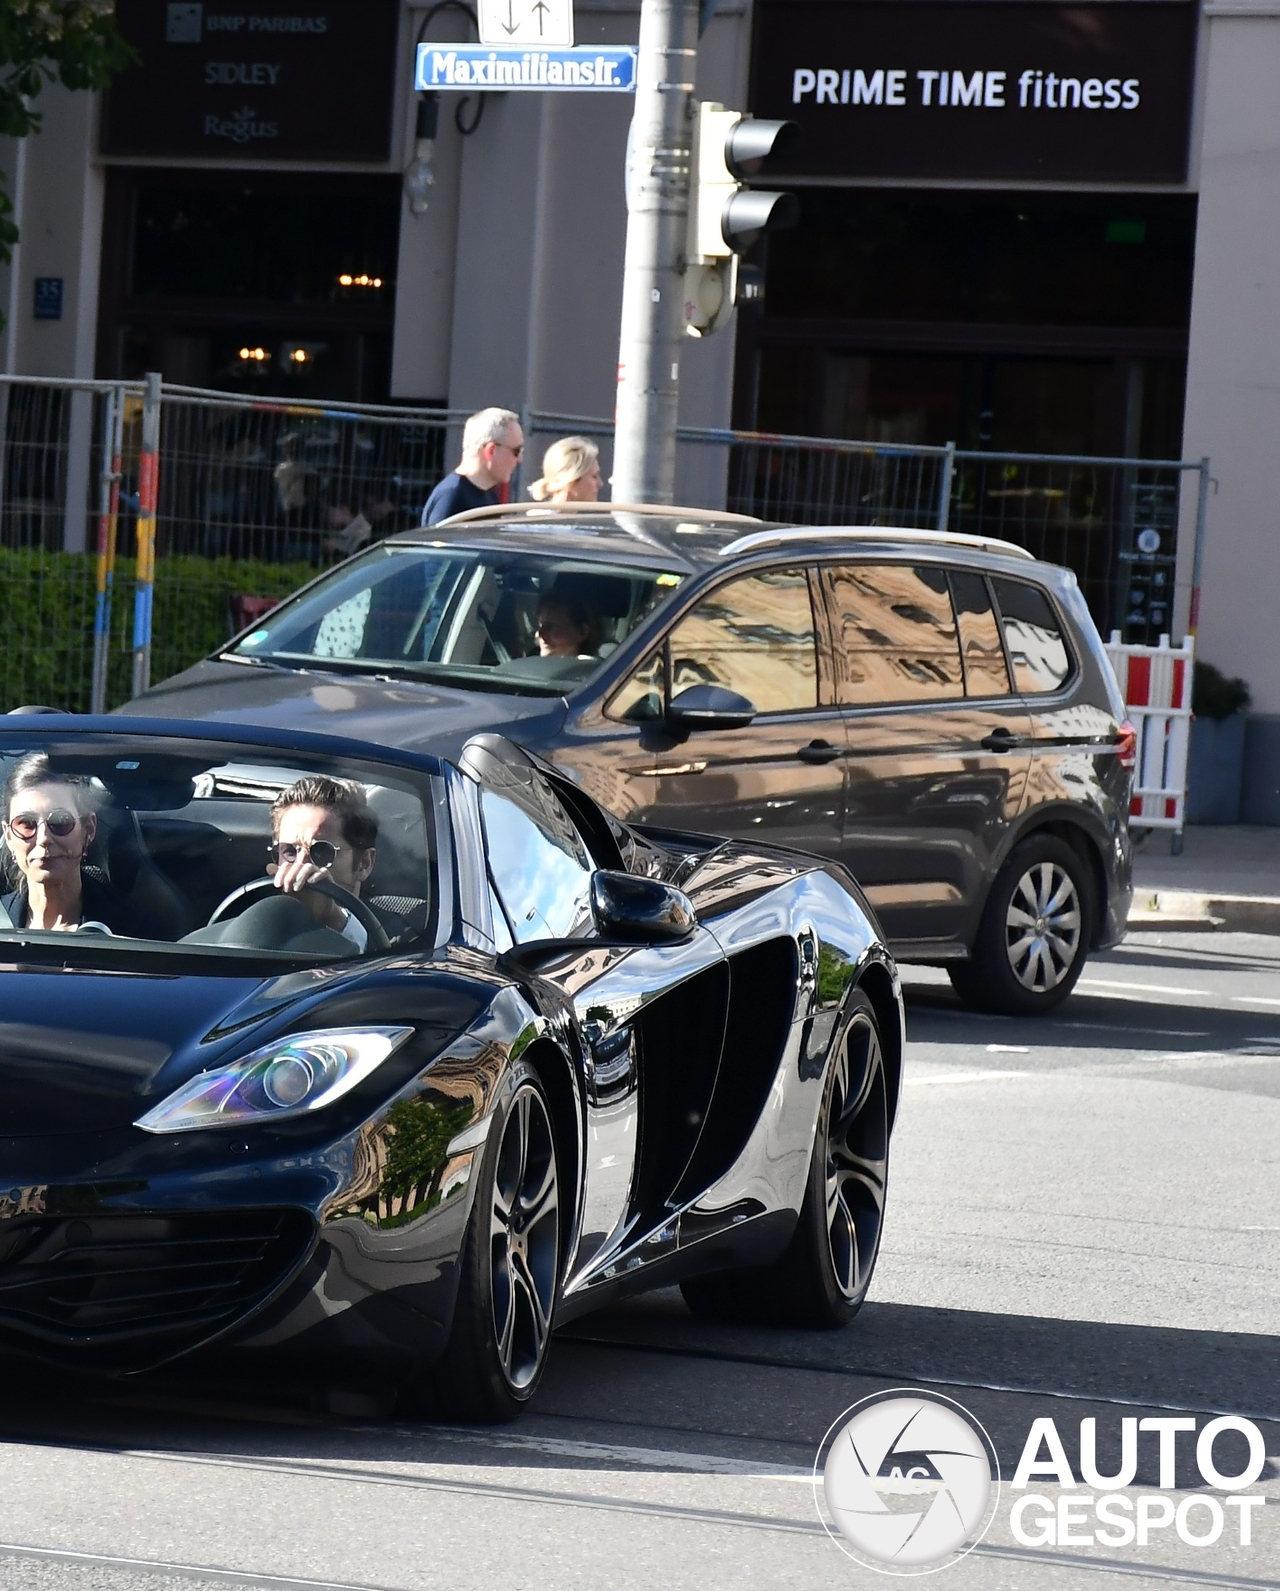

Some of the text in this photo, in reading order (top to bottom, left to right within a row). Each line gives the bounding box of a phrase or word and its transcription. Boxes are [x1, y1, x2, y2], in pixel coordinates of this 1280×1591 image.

[206, 15, 328, 33] BNP PARIBAS
[204, 62, 281, 85] SIDLEY
[431, 51, 622, 86] Maximilianstr.
[793, 69, 1141, 110] PRIME TIME fitness
[204, 110, 279, 143] Regus
